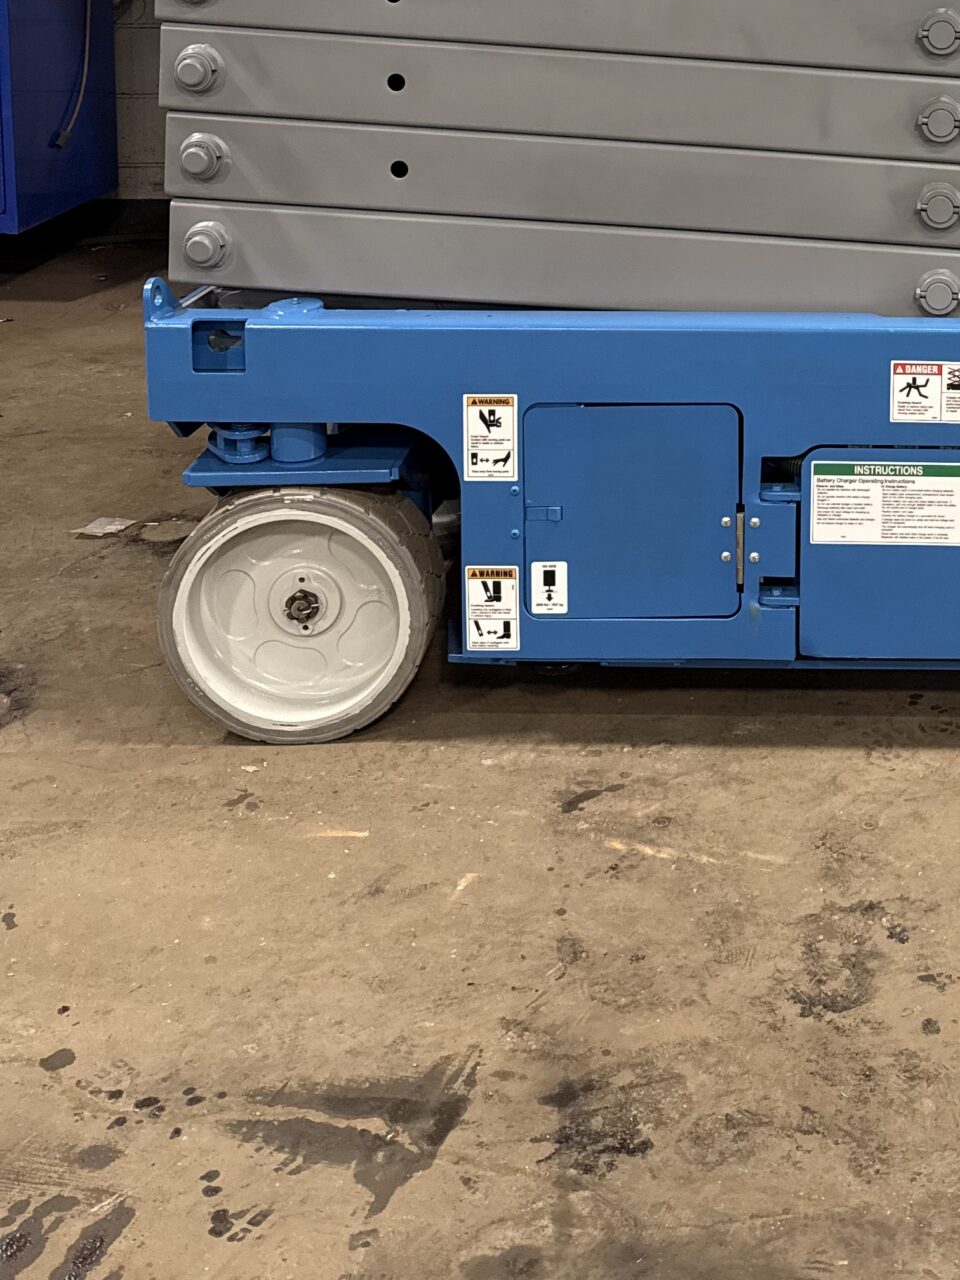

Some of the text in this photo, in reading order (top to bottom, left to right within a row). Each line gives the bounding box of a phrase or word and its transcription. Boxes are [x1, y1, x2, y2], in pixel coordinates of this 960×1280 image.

[905, 365, 939, 374] DANGER
[854, 465, 924, 476] INSTRUCTIONS
[816, 477, 836, 485] Battery
[478, 570, 513, 578] WARNING
